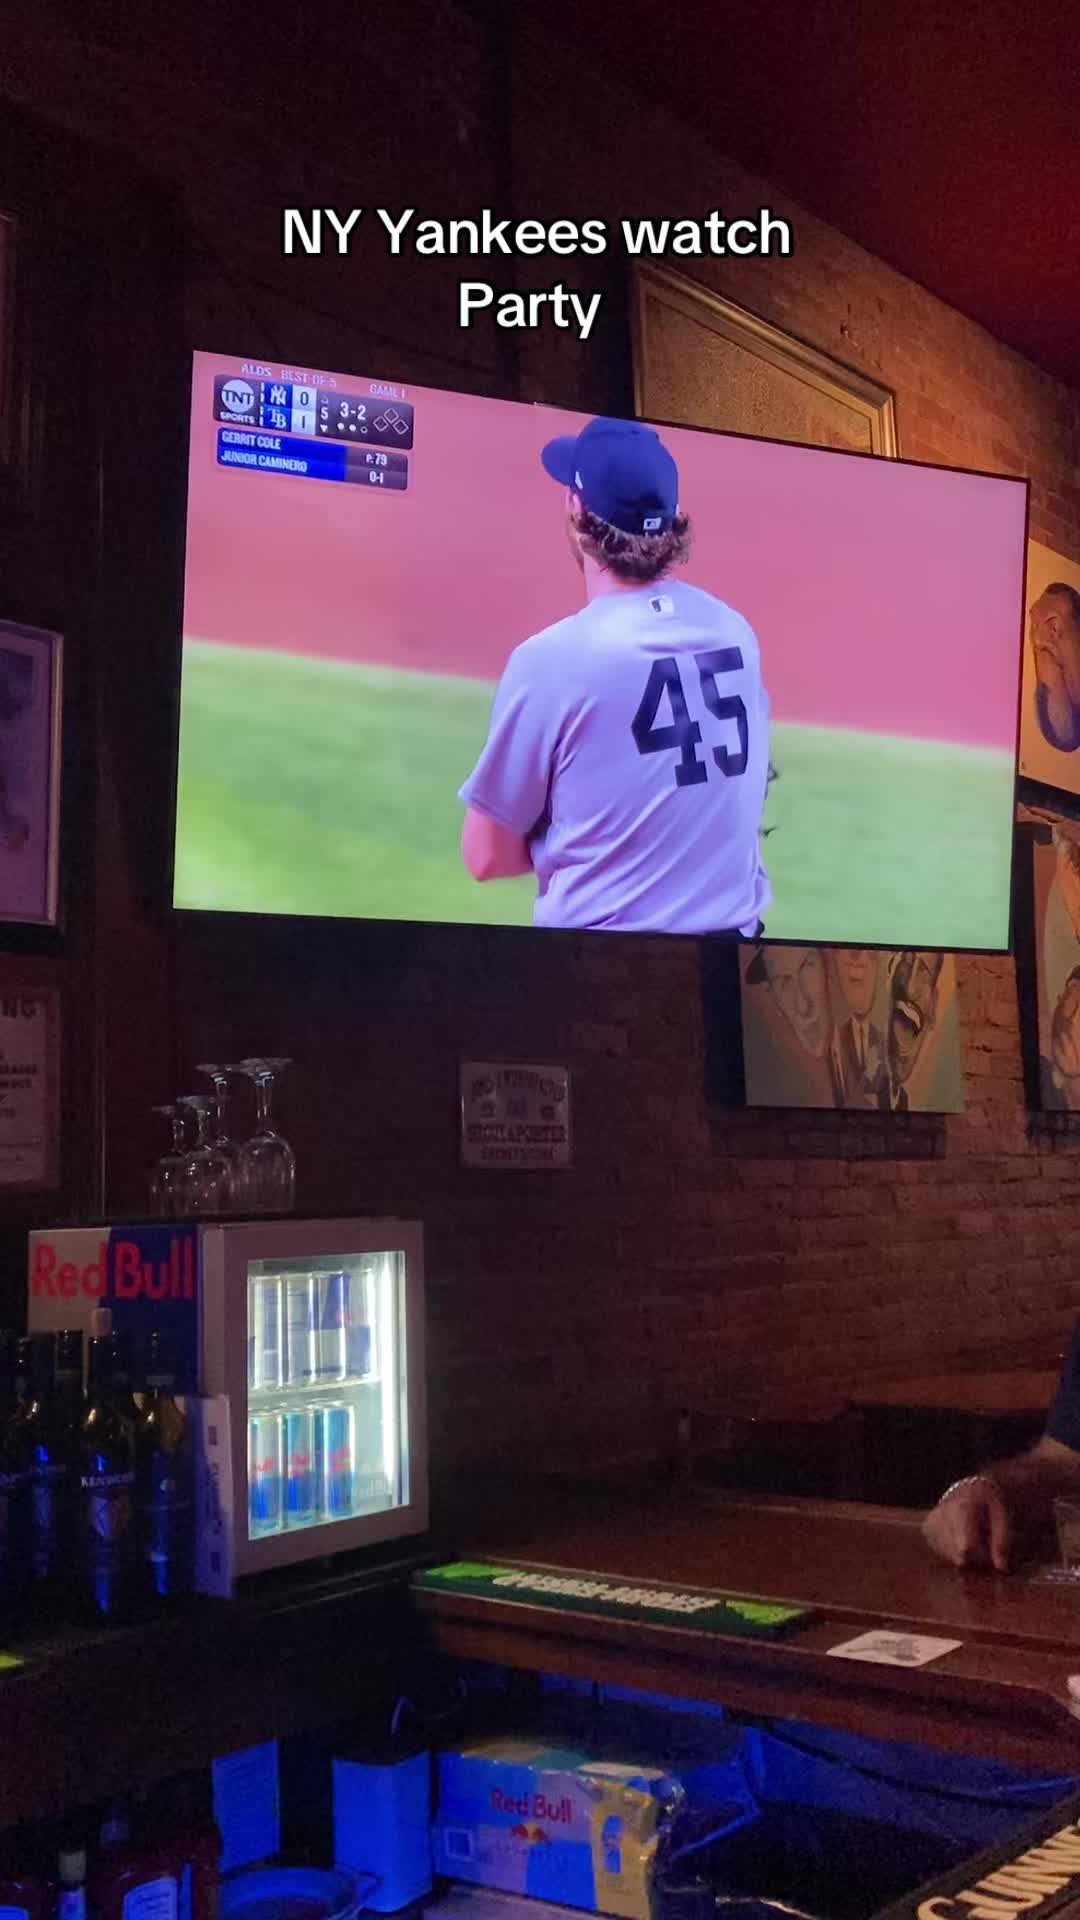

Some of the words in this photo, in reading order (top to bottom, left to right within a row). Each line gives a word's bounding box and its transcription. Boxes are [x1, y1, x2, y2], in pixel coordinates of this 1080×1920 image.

[241, 363, 272, 376] ALDS
[299, 391, 310, 406] 0
[220, 411, 255, 424] SPORTS
[268, 407, 287, 428] TB
[320, 406, 329, 420] 5
[340, 401, 367, 421] 3-2
[221, 430, 256, 447] GERRIT
[257, 435, 281, 450] COLE
[221, 449, 257, 467] JUNIOR
[258, 454, 309, 473] CAMINERO
[369, 470, 384, 484] 0-1
[630, 646, 749, 788] 45
[31, 1240, 109, 1299] Red
[114, 1234, 194, 1300] Bull
[491, 1784, 529, 1817] Red
[533, 1793, 573, 1826] Bull
